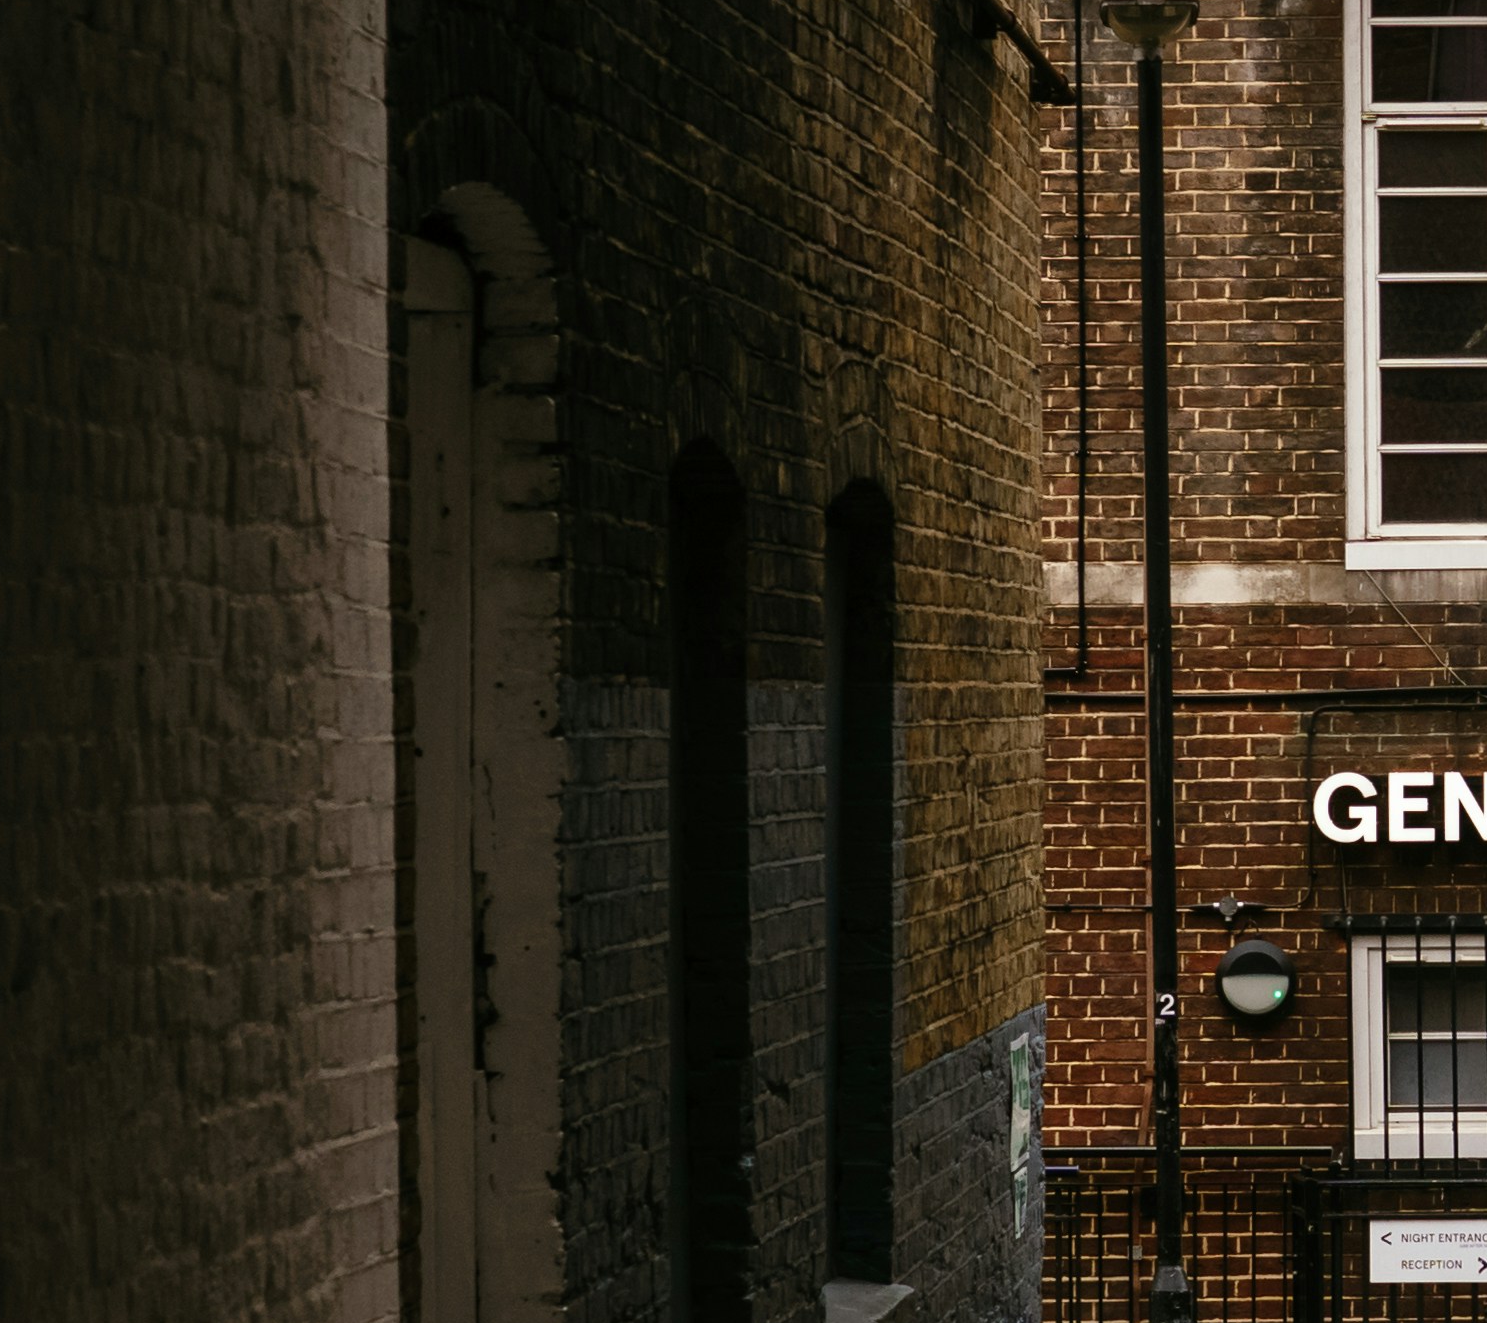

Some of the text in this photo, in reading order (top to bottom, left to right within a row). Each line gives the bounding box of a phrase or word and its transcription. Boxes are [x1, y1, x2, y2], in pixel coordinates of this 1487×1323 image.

[1159, 993, 1176, 1016] 2
[1400, 1233, 1435, 1243] NIGHT
[1401, 1260, 1463, 1270] RECEPTION
